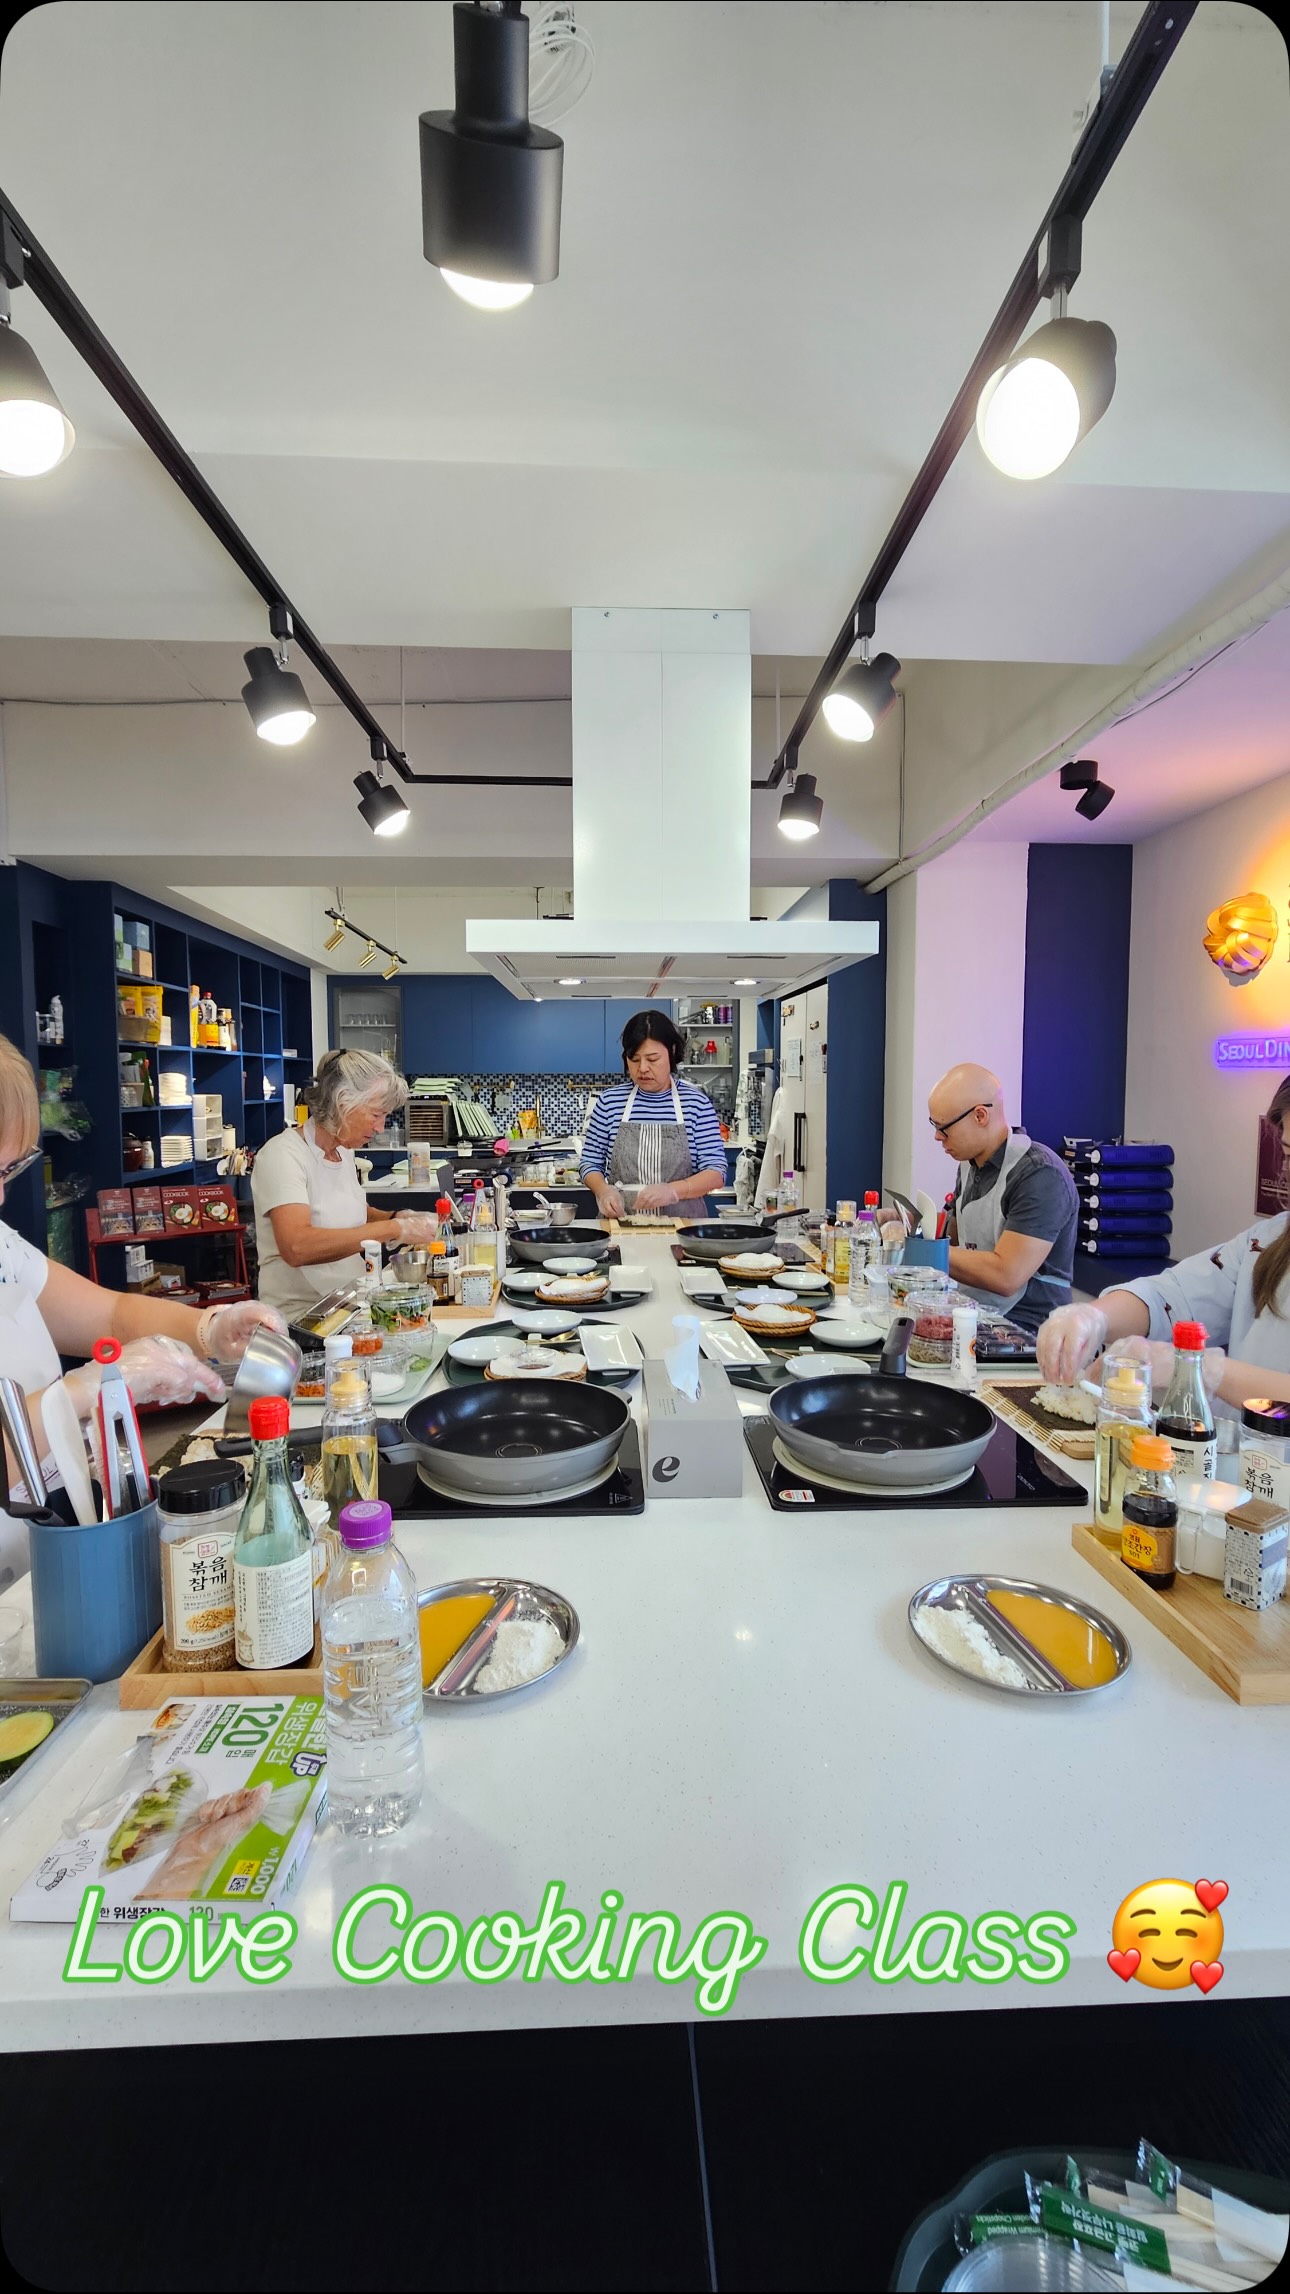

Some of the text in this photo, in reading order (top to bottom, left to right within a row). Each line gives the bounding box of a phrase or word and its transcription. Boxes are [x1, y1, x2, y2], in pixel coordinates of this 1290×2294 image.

[652, 1456, 681, 1483] e
[1246, 1467, 1274, 1486] 볶음
[1244, 1479, 1274, 1499] 참깨
[189, 1556, 227, 1576] 볶음
[189, 1570, 227, 1592] 참깨
[222, 1703, 284, 1747] 120
[265, 1702, 317, 1765] 위생장갑
[975, 2213, 1012, 2223] Chopsticks
[987, 2225, 1018, 2236] Wrapped
